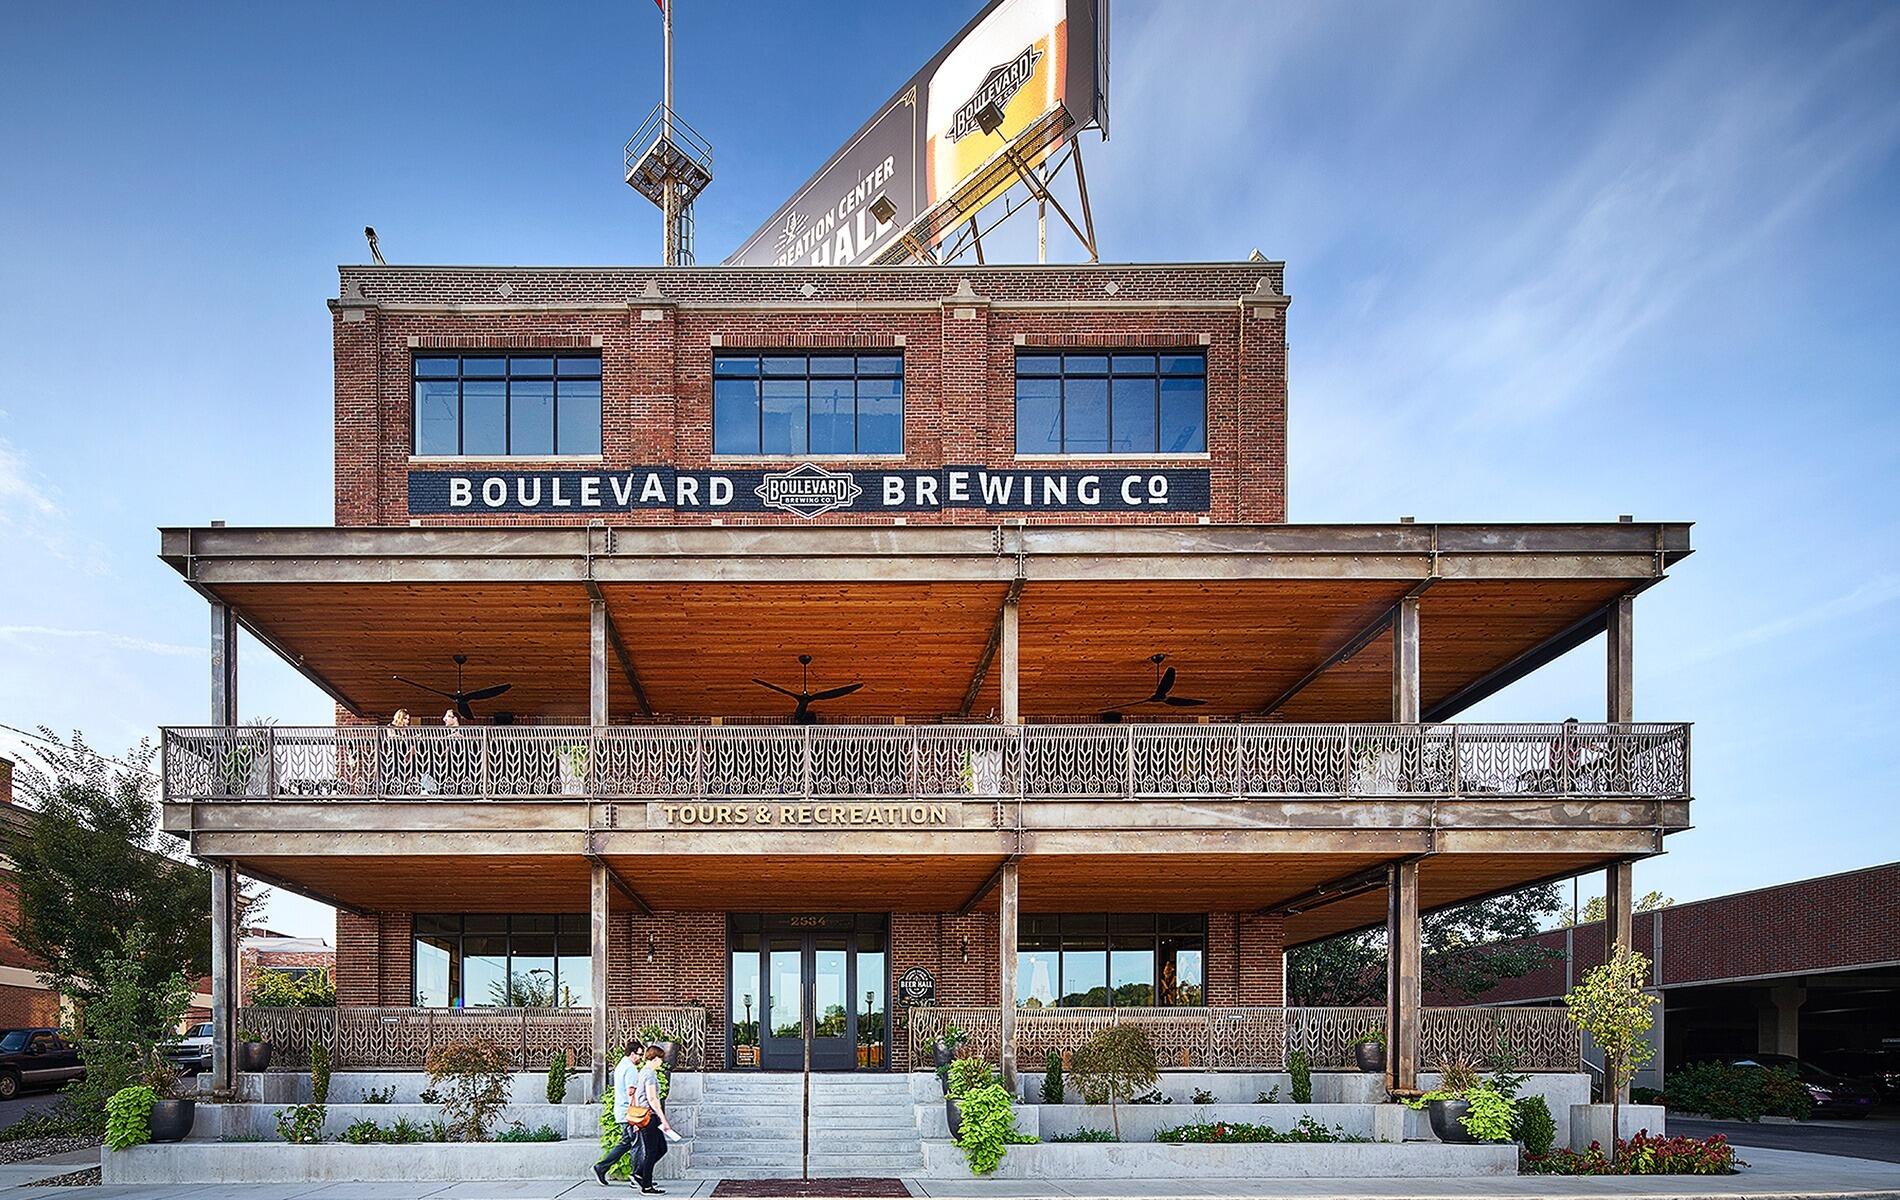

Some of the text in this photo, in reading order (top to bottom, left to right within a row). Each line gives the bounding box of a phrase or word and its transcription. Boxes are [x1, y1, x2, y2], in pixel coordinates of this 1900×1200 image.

[956, 56, 1029, 138] BOULEVARD
[772, 155, 894, 265] REATION CENTER
[450, 473, 735, 507] BOULEVARD
[883, 471, 1100, 505] BREWING
[770, 479, 846, 500] BOULEVARD
[664, 804, 947, 824] TOURS & RECREATION
[900, 980, 933, 988] BEER HALL
